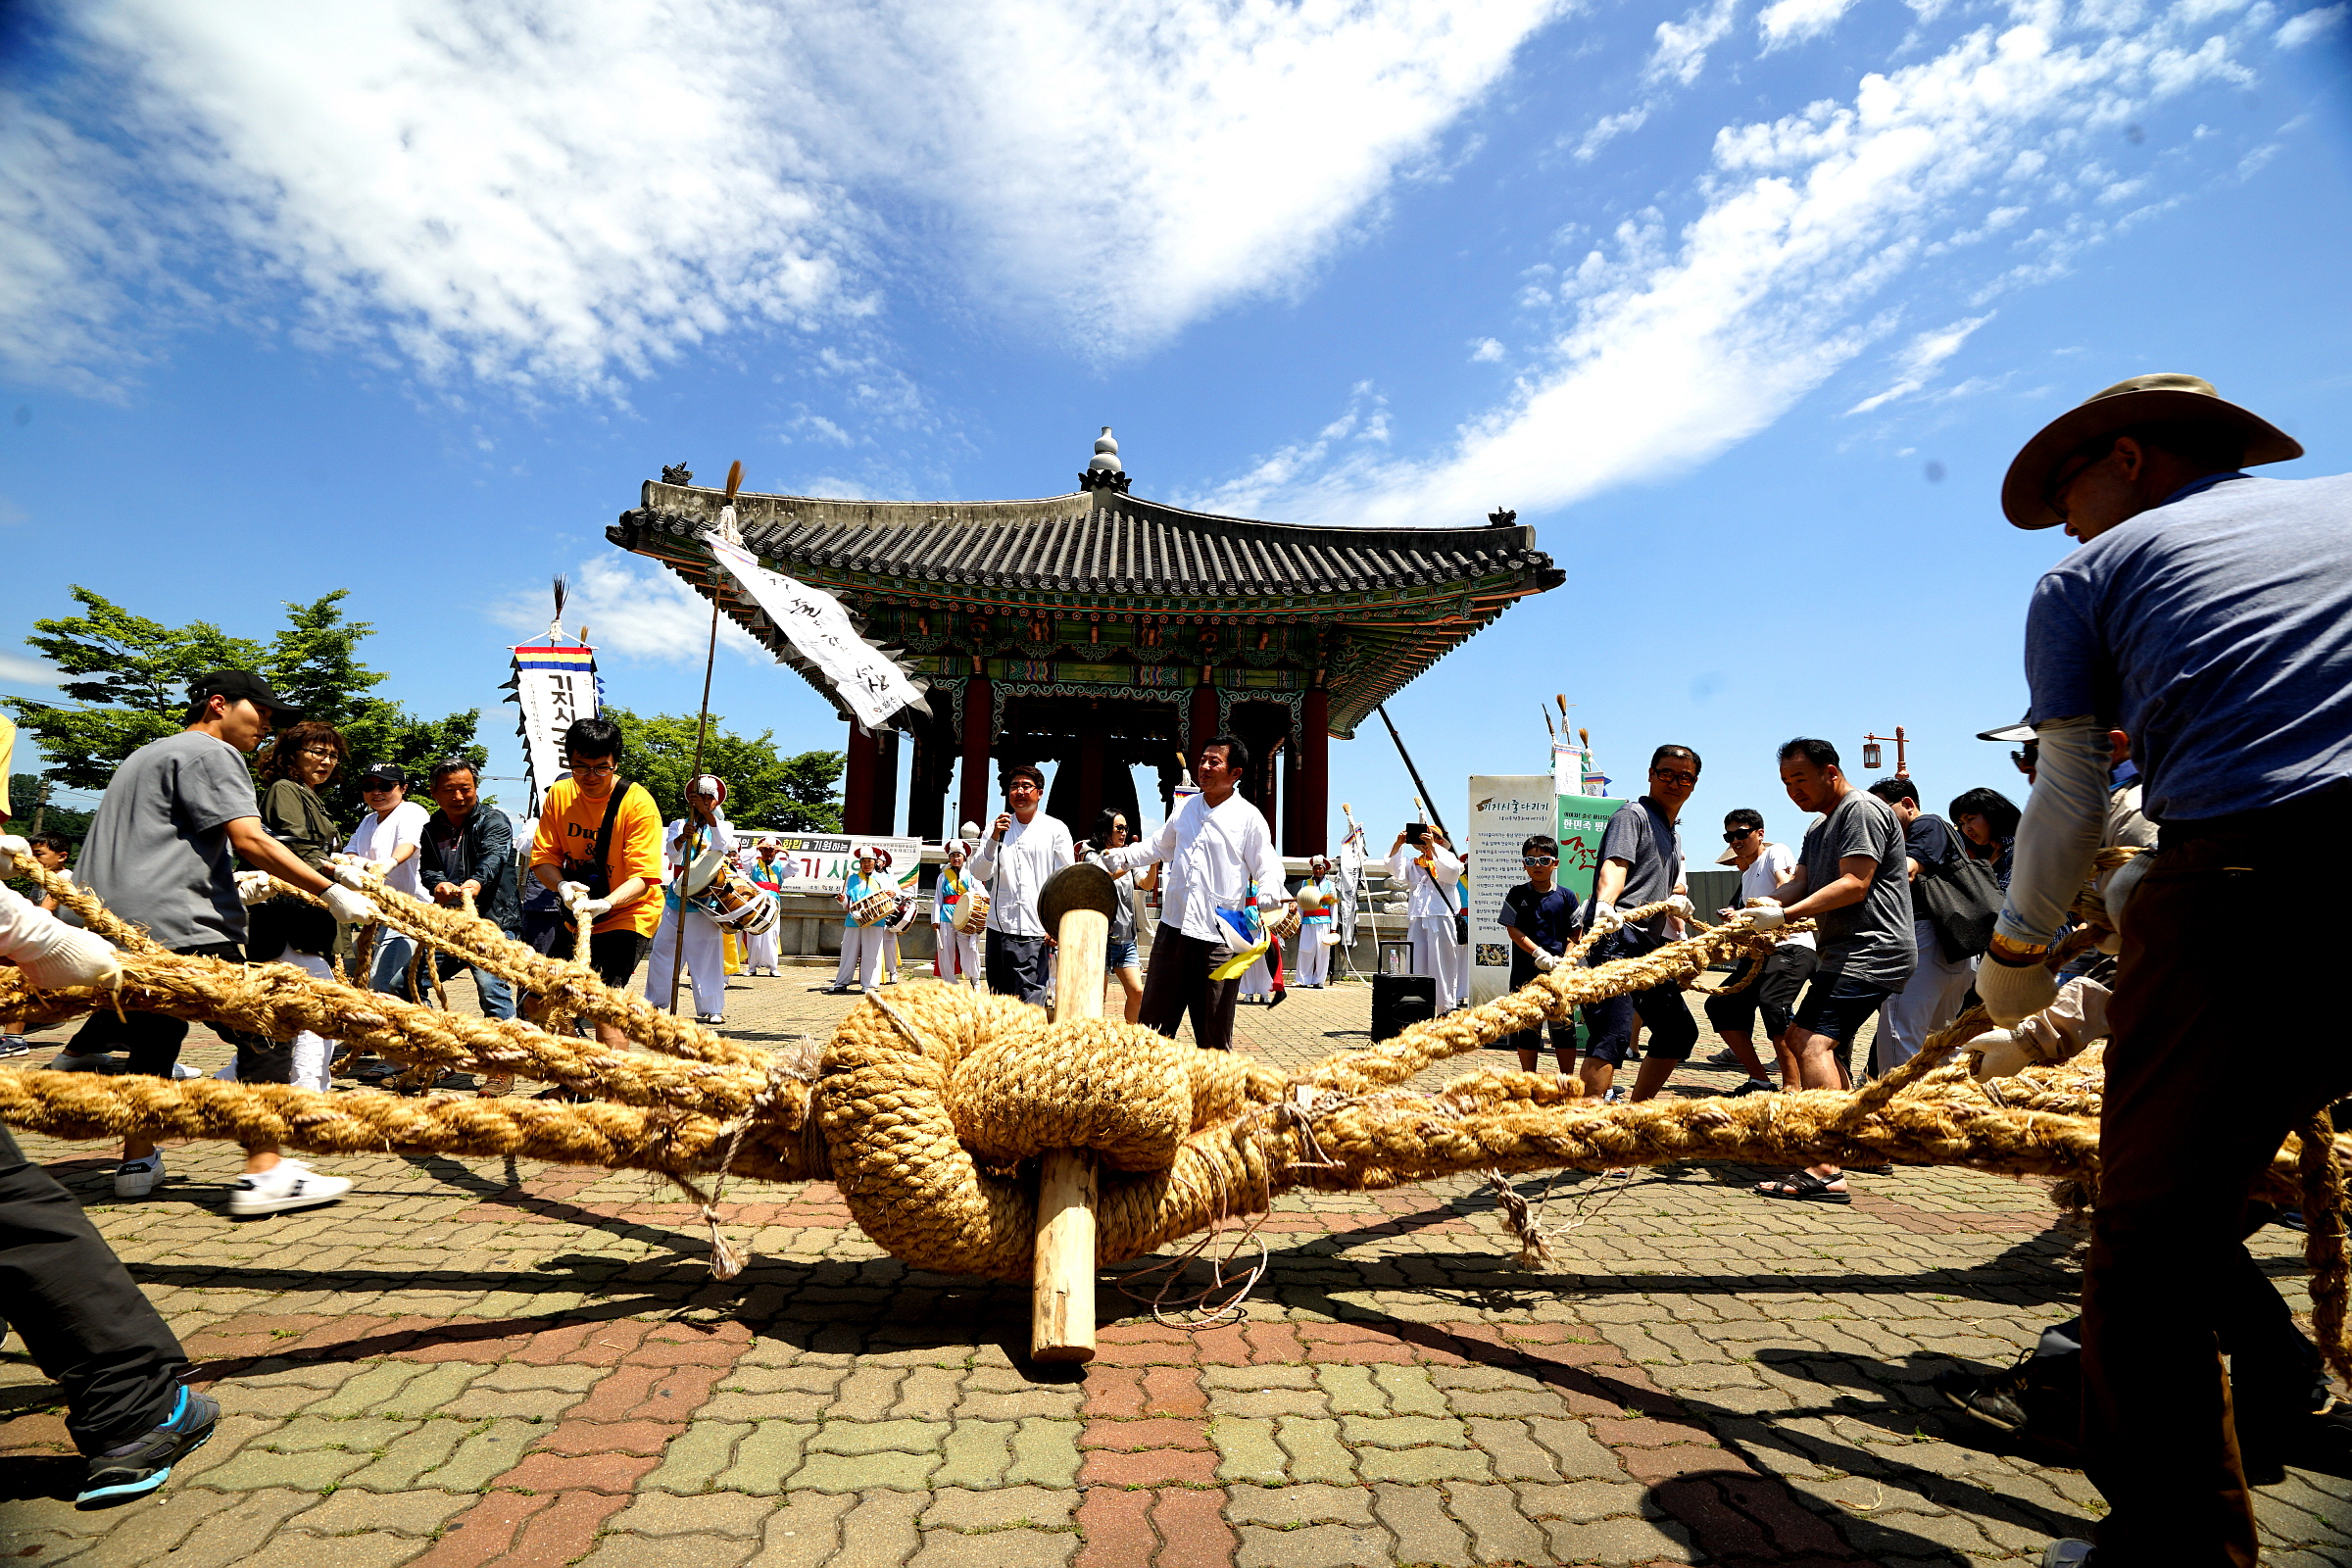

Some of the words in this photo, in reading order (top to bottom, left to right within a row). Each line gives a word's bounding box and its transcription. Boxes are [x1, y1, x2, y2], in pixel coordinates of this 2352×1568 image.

[1484, 799, 1549, 814] 기지시줄다리기
[1563, 818, 1592, 831] 한민족
[812, 840, 849, 852] 기원하는
